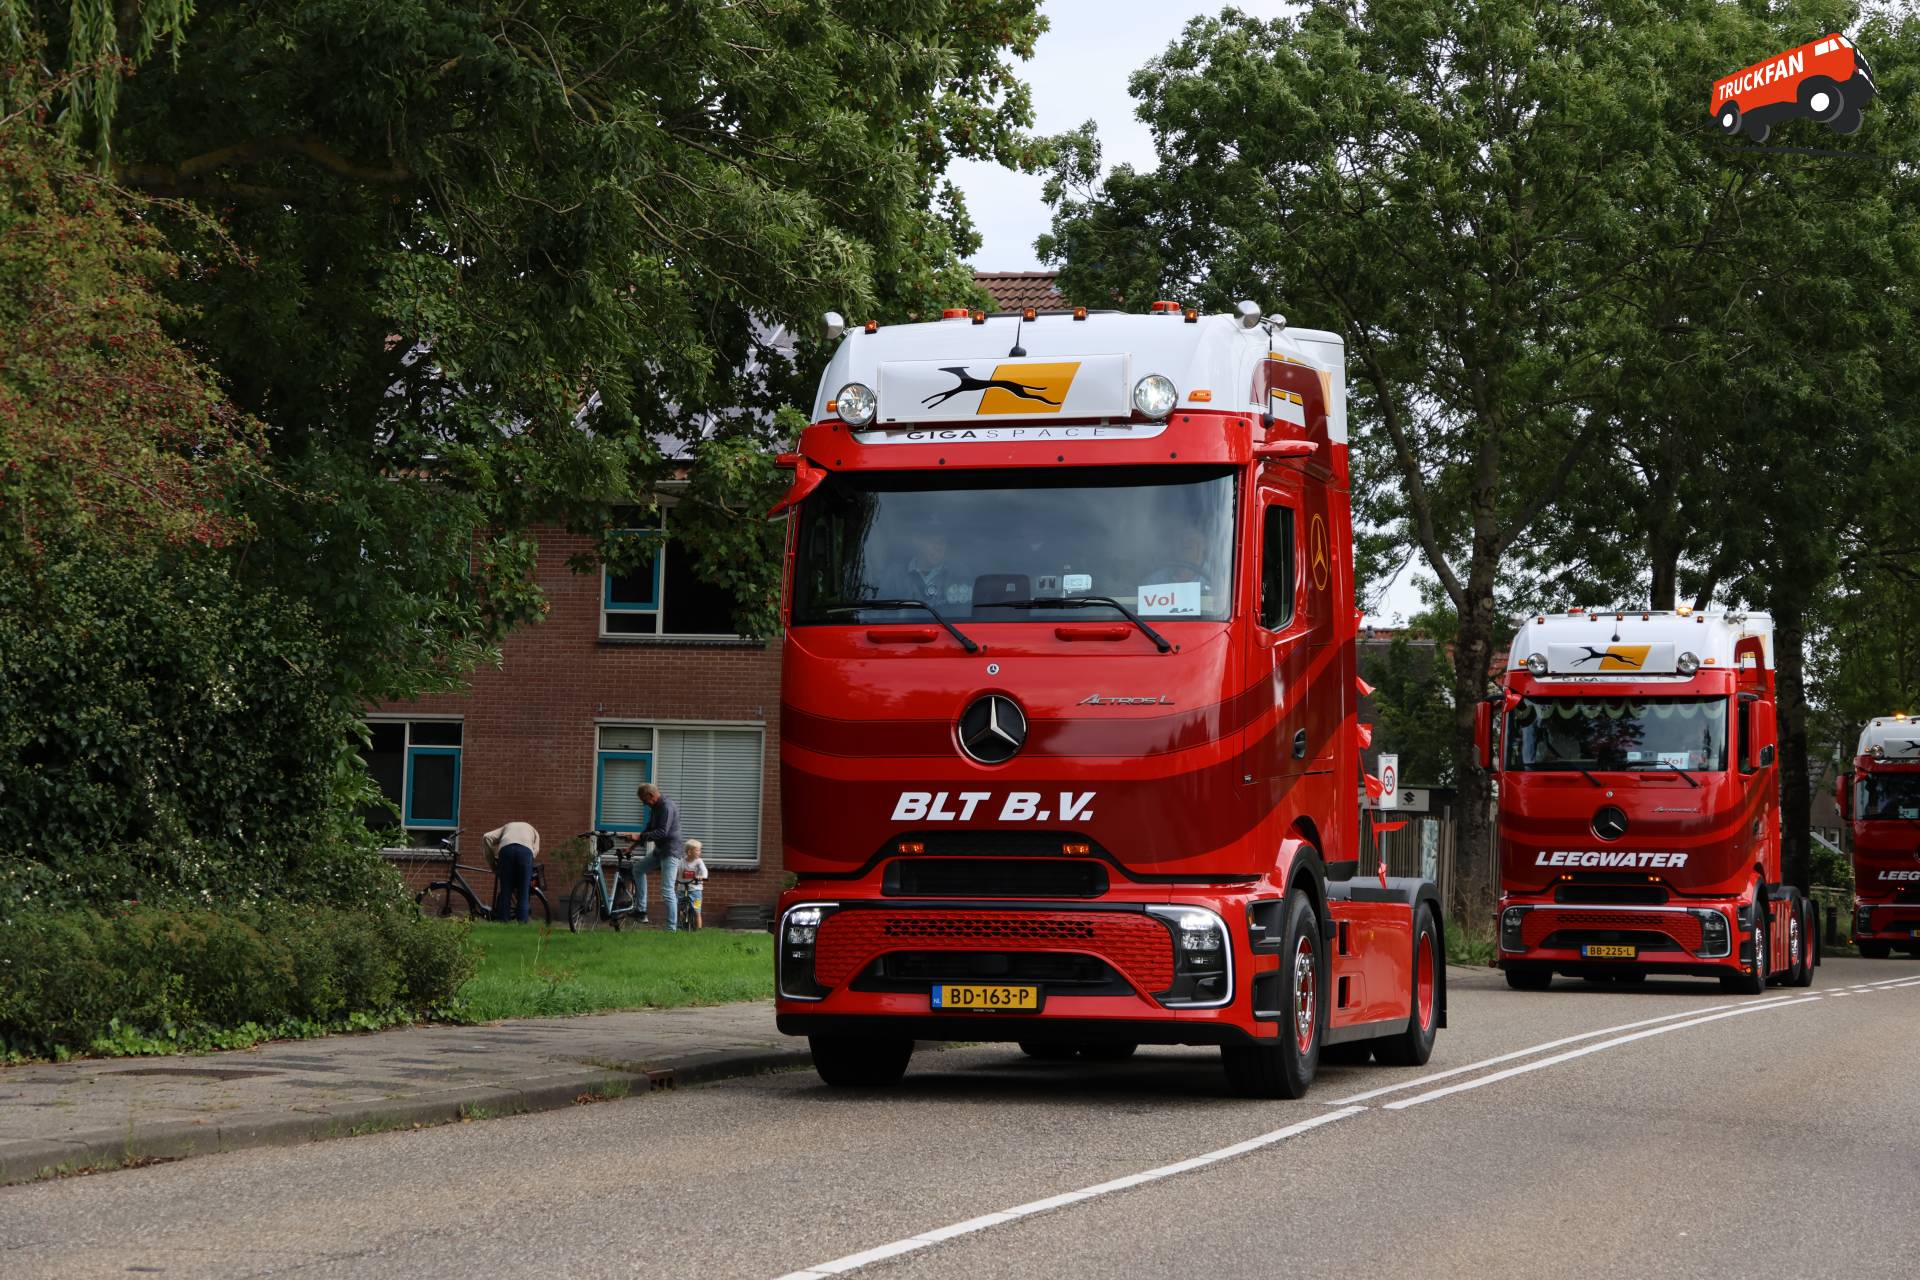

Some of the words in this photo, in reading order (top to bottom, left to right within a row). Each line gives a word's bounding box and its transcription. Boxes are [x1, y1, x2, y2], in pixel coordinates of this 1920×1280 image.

[1143, 592, 1175, 607] Vol
[890, 791, 992, 821] BLT
[998, 791, 1097, 821] B.V.
[1535, 851, 1689, 868] LEEGWATER
[951, 988, 1030, 1005] BD-163-P
